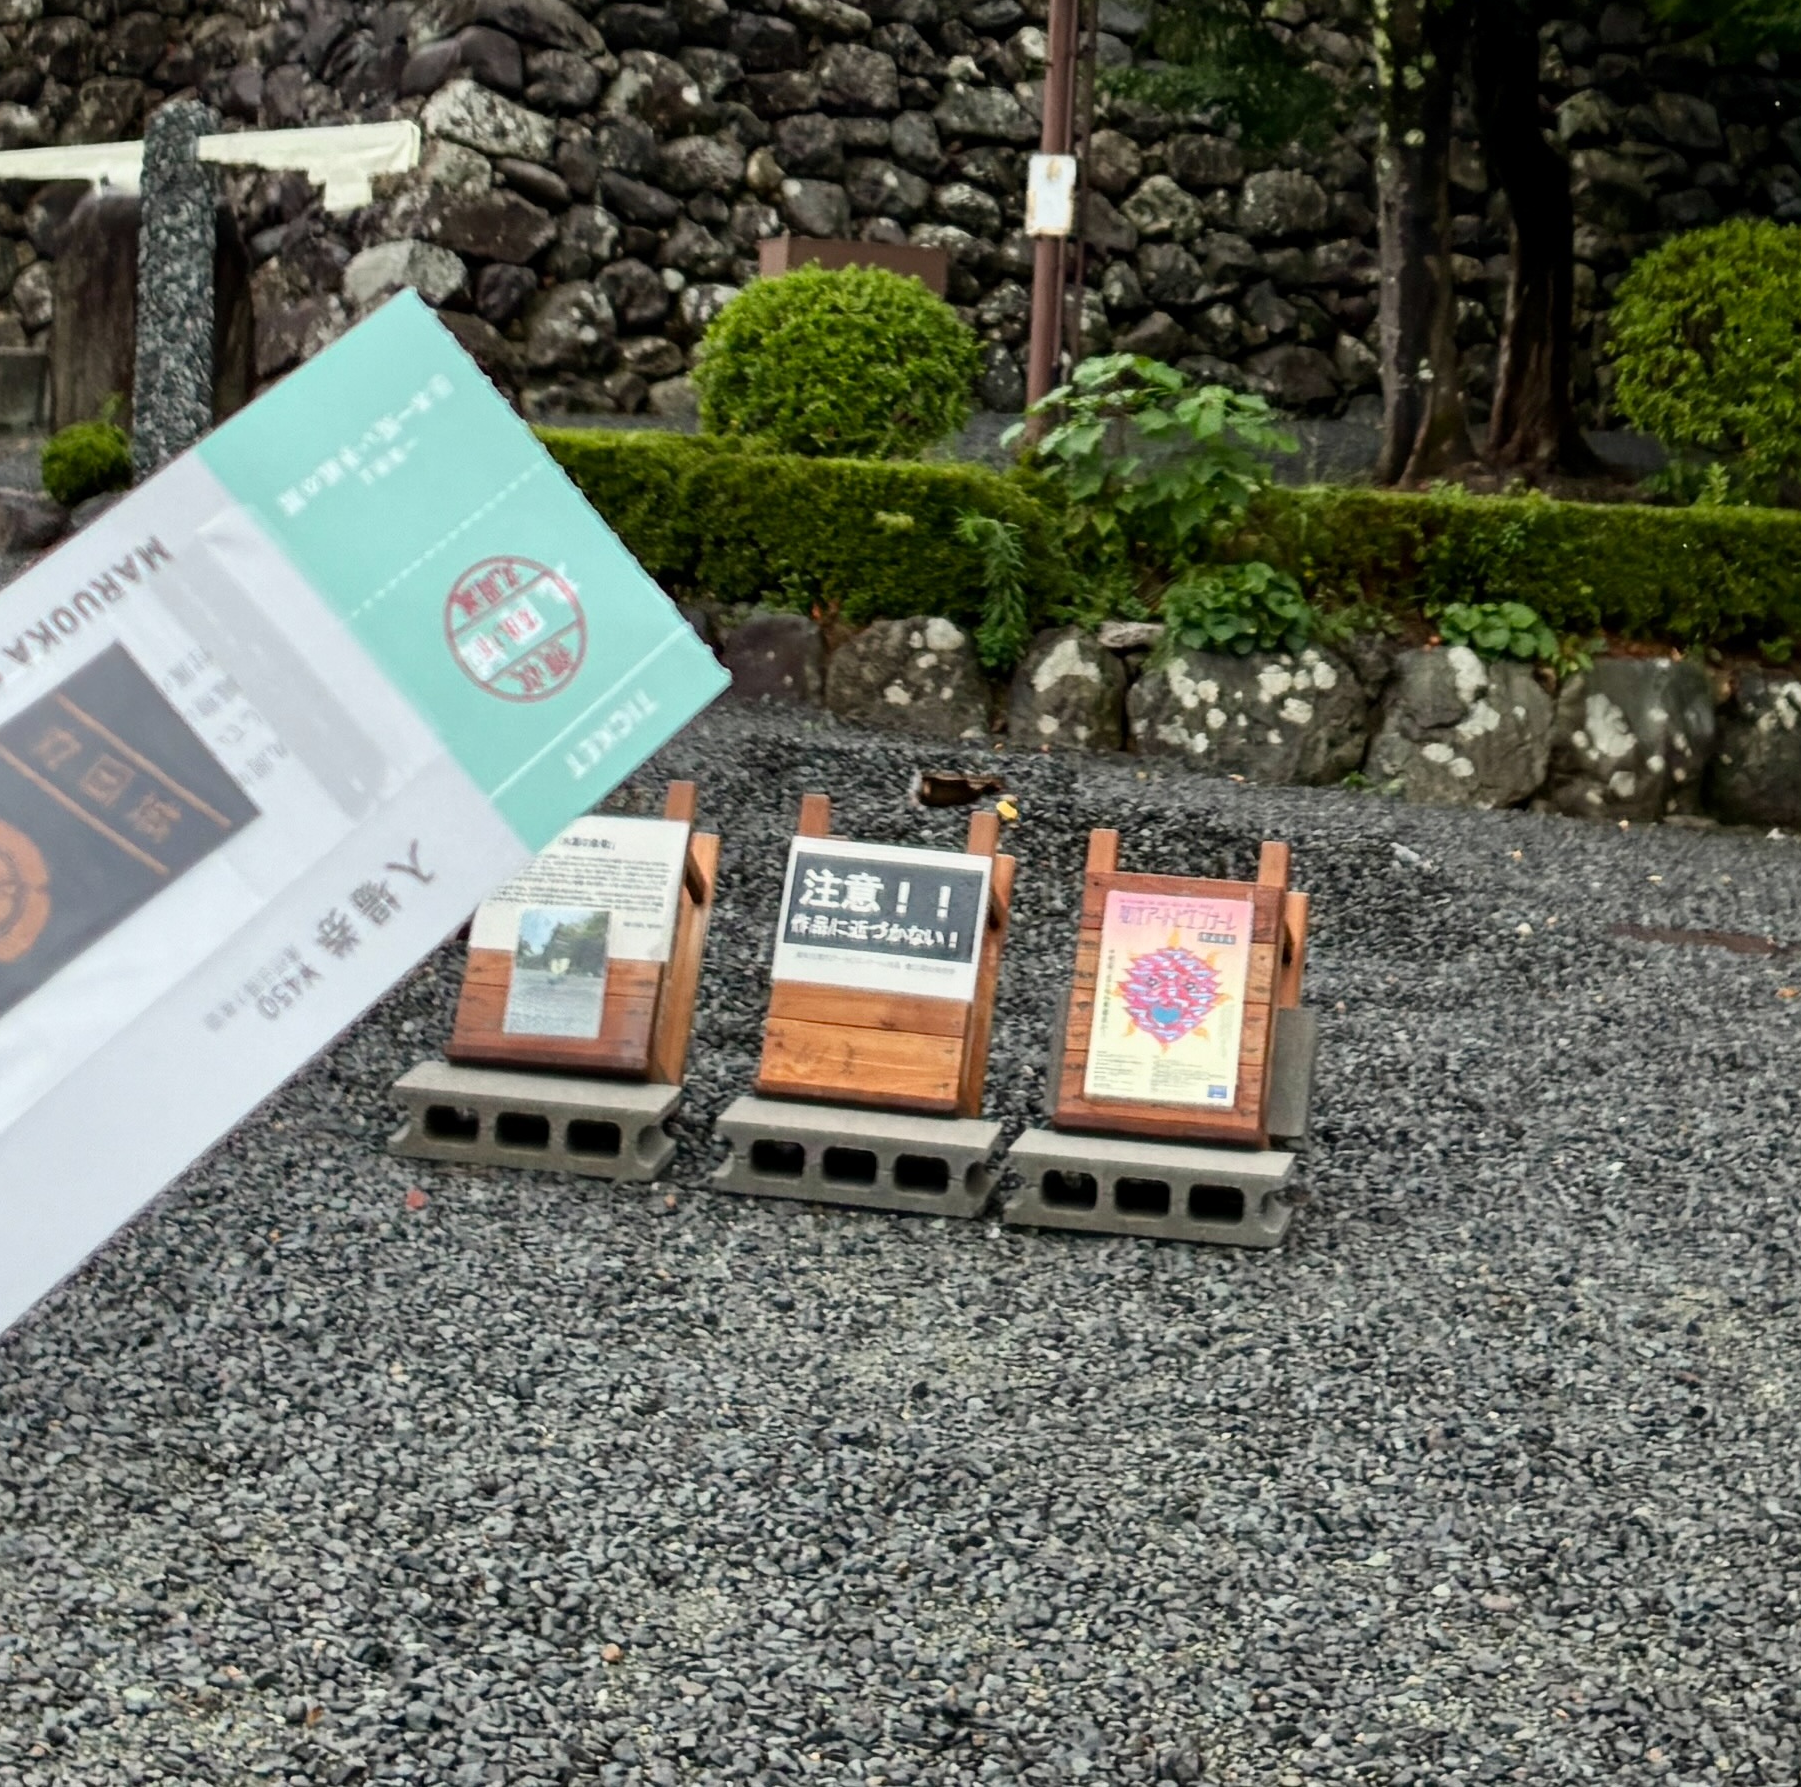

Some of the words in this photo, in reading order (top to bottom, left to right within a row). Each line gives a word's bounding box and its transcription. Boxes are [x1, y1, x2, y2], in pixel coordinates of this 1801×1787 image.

[1, 534, 172, 675] MARUOKA
[32, 722, 184, 848] 丸岡城
[562, 685, 660, 781] TICKET
[308, 836, 447, 965] 入場券
[254, 960, 325, 1025] ¥450
